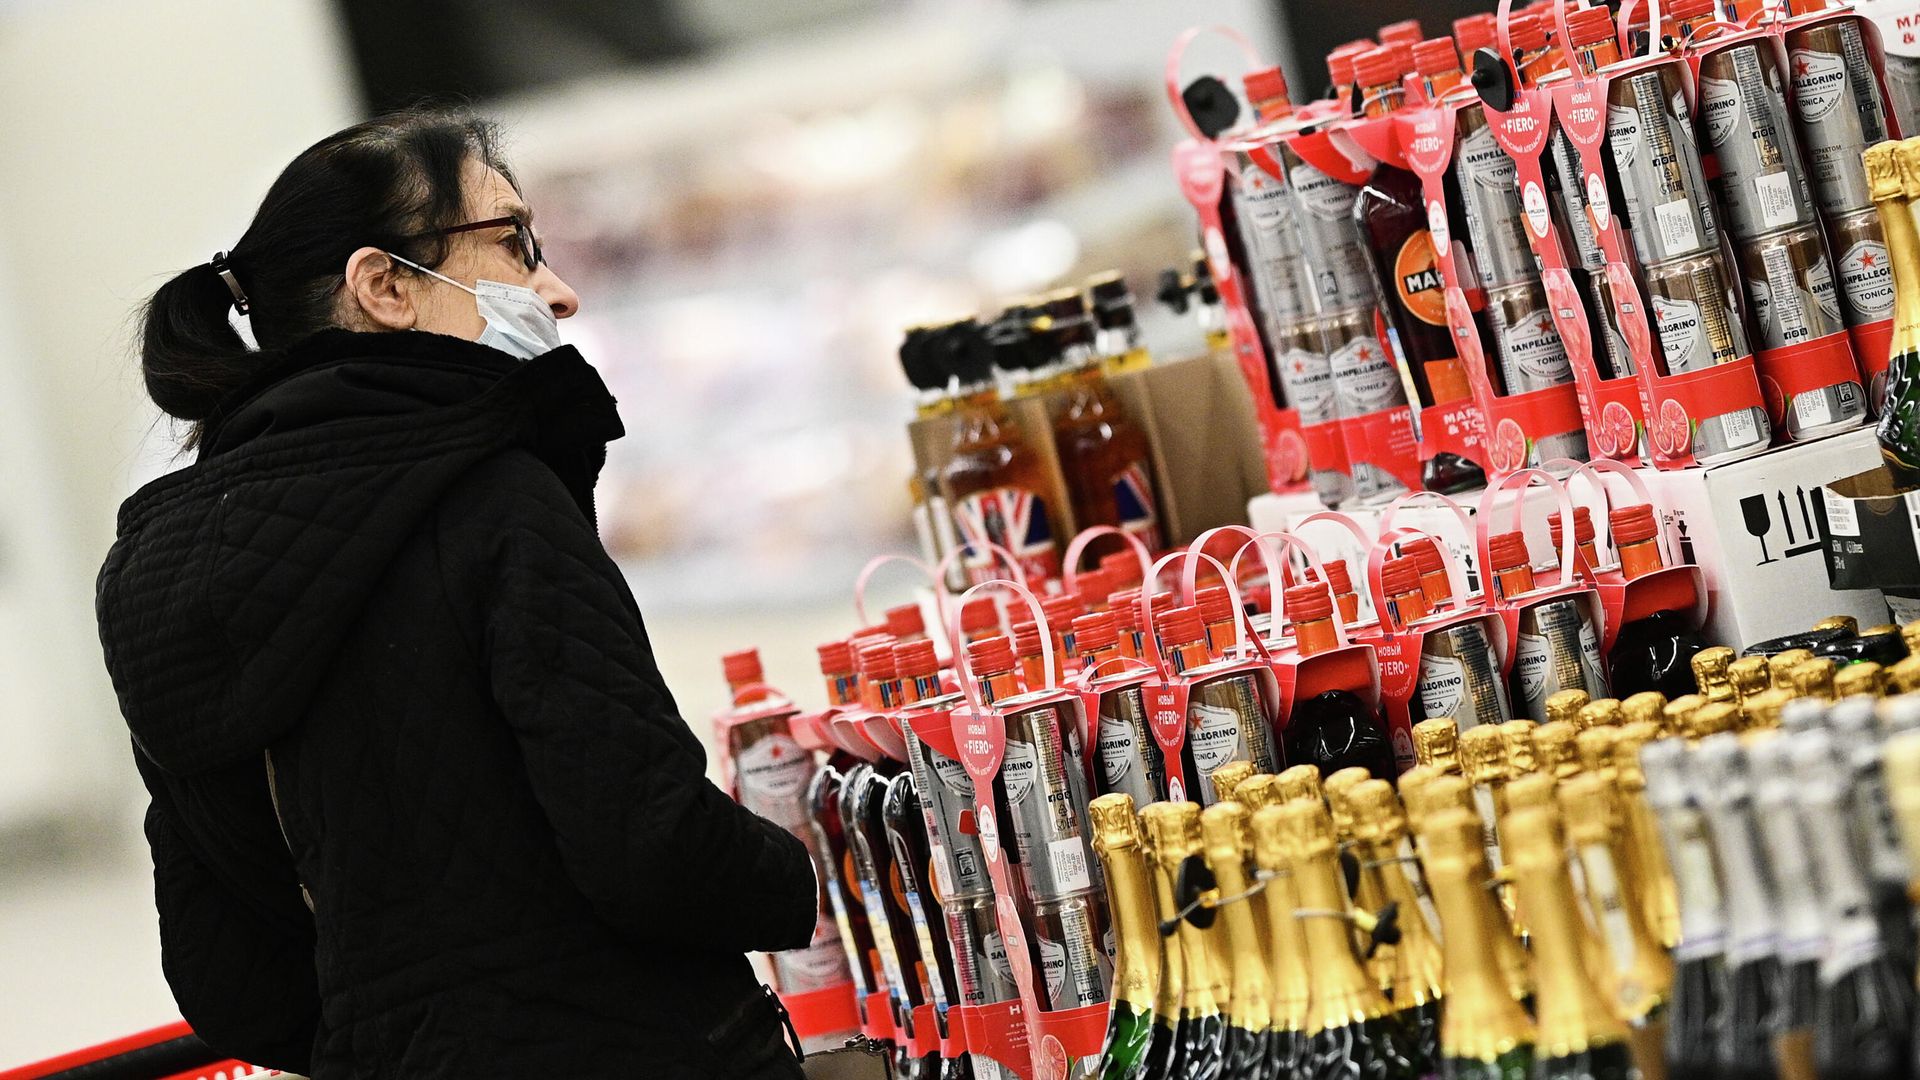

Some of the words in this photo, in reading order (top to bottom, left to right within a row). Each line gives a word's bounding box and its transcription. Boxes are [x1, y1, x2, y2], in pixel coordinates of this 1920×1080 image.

[1570, 91, 1592, 105] НОВЫЙ
[1859, 287, 1894, 301] TONICA
[1379, 643, 1402, 656] НОВЫЙ
